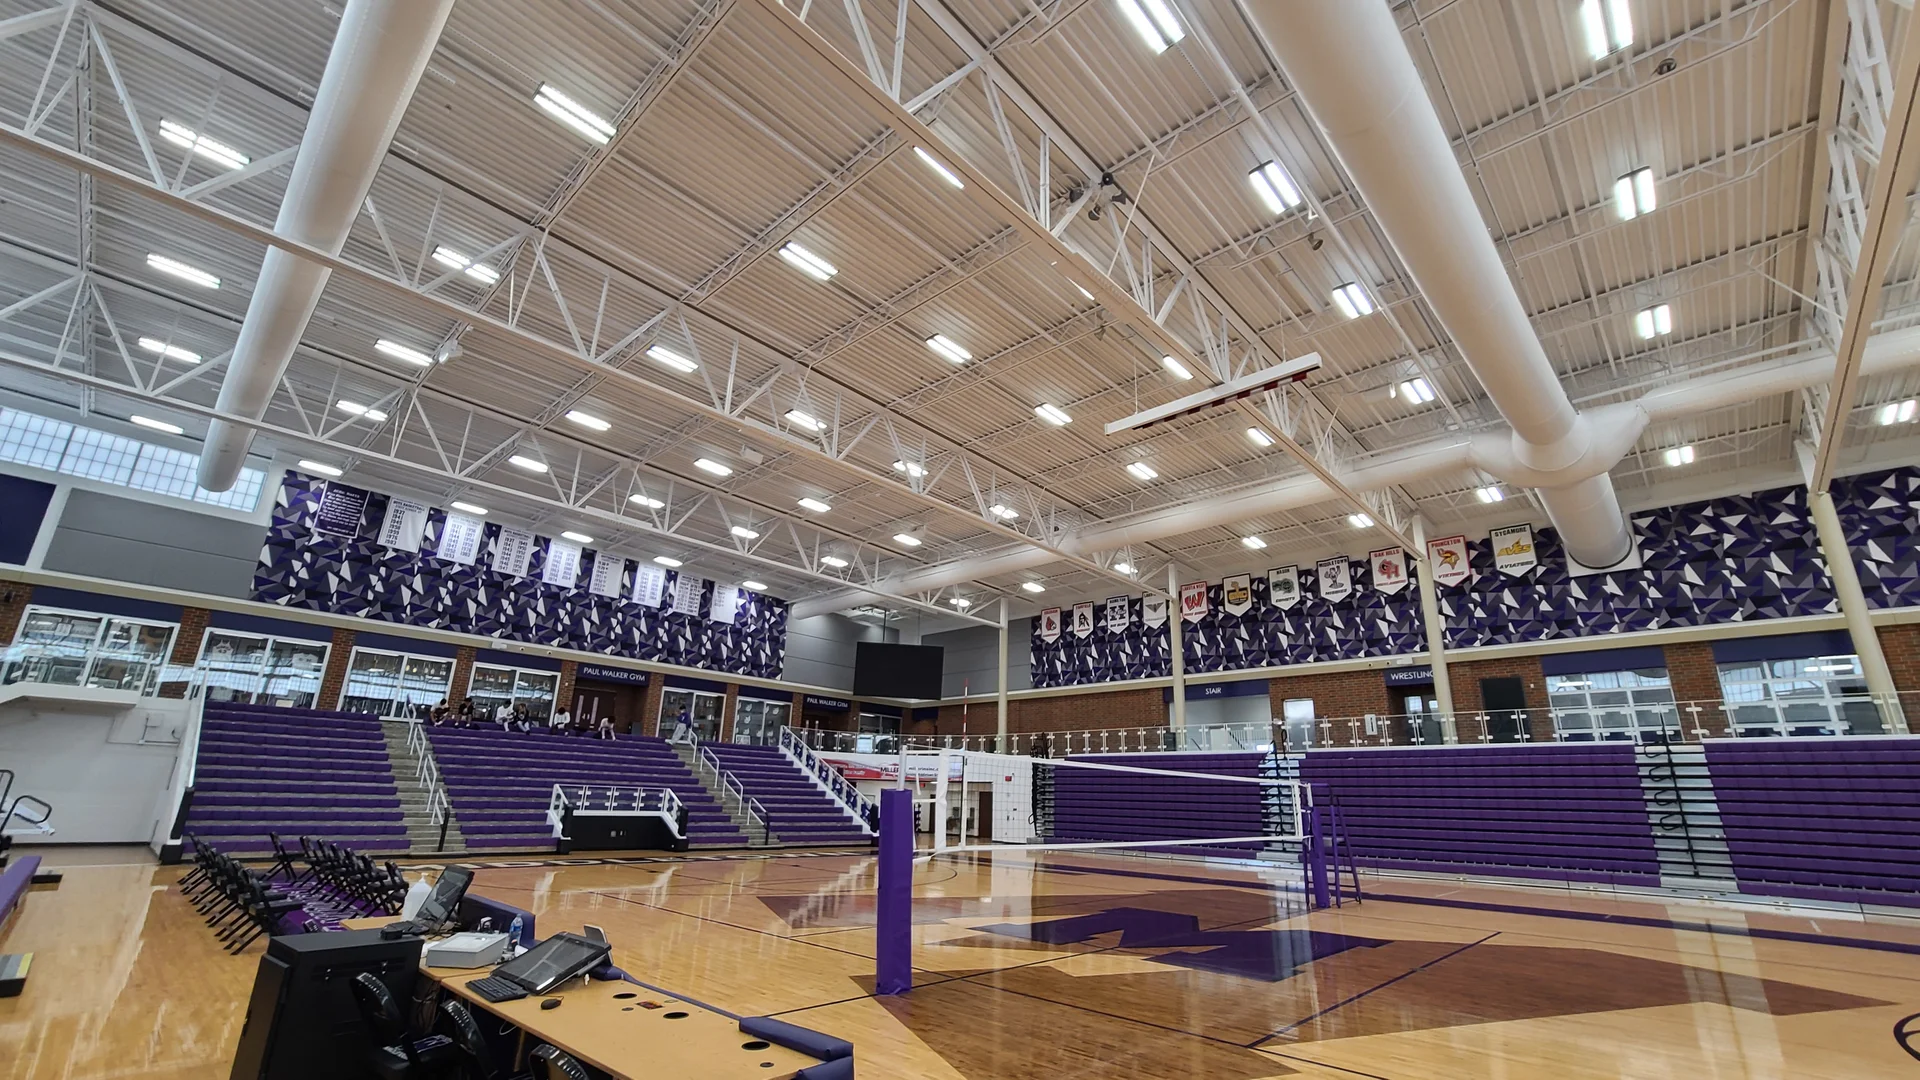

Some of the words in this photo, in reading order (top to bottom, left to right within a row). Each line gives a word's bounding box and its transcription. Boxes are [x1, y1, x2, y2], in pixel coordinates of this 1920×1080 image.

[1494, 527, 1527, 537] SYCAMORE
[1432, 539, 1461, 548] PRINCETON
[1497, 539, 1532, 557] AVES
[1319, 559, 1347, 567] MIDDLETOWN
[1500, 561, 1534, 569] AVIATORS
[1185, 591, 1204, 611] W
[584, 667, 600, 676] PAUL
[602, 669, 628, 679] WALKER
[629, 673, 646, 681] GYM
